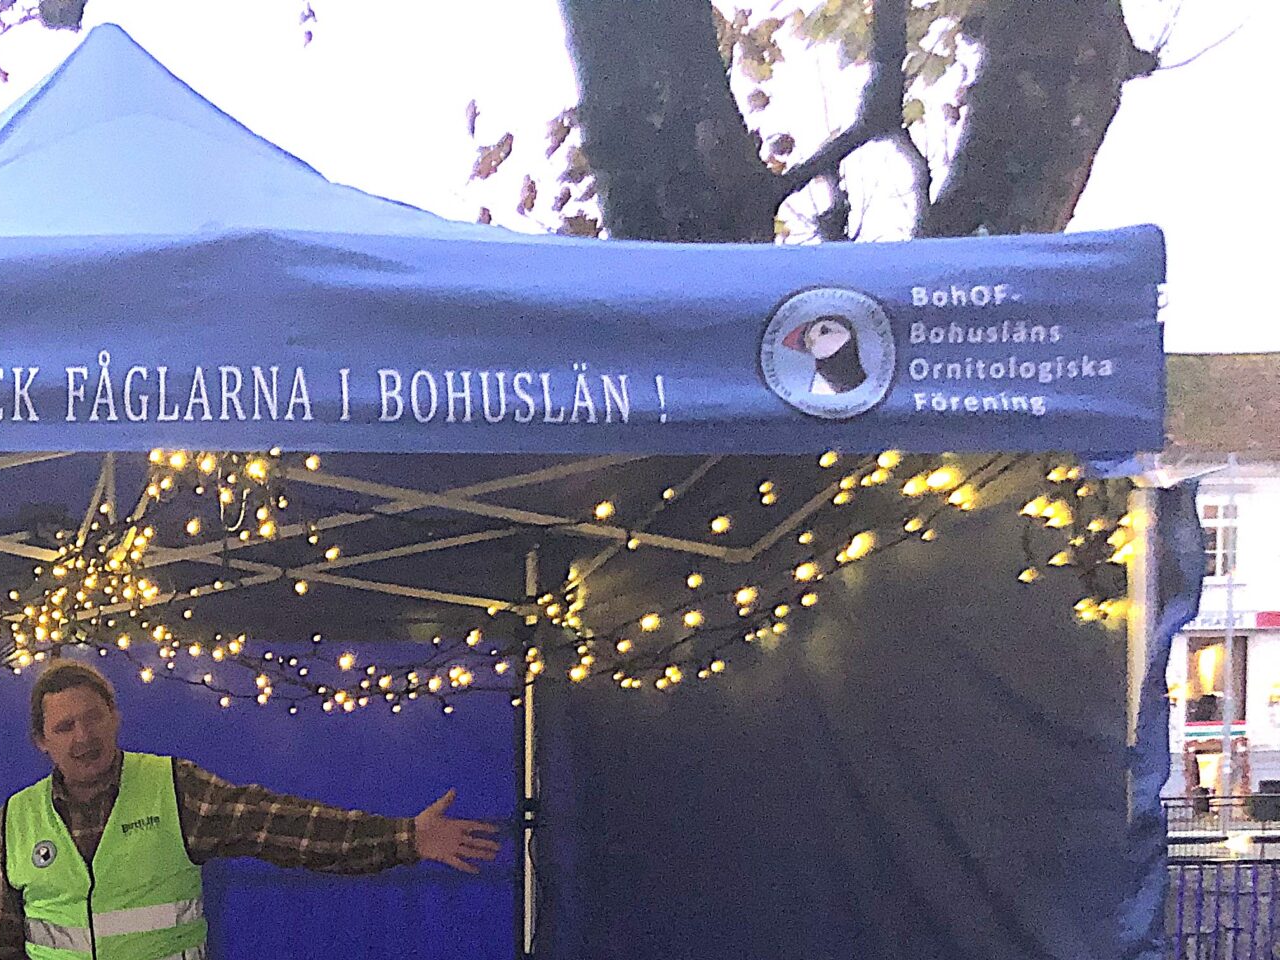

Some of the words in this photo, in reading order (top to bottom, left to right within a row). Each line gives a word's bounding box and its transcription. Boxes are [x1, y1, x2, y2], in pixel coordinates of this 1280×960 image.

[909, 321, 1062, 344] Bohusläns
[908, 355, 1113, 383] Ornitologiska
[65, 350, 314, 422] FÅGLARNA
[338, 367, 352, 423] I
[377, 361, 631, 424] BOHUSLÄN
[656, 374, 669, 423] !
[914, 392, 1047, 416] Förening
